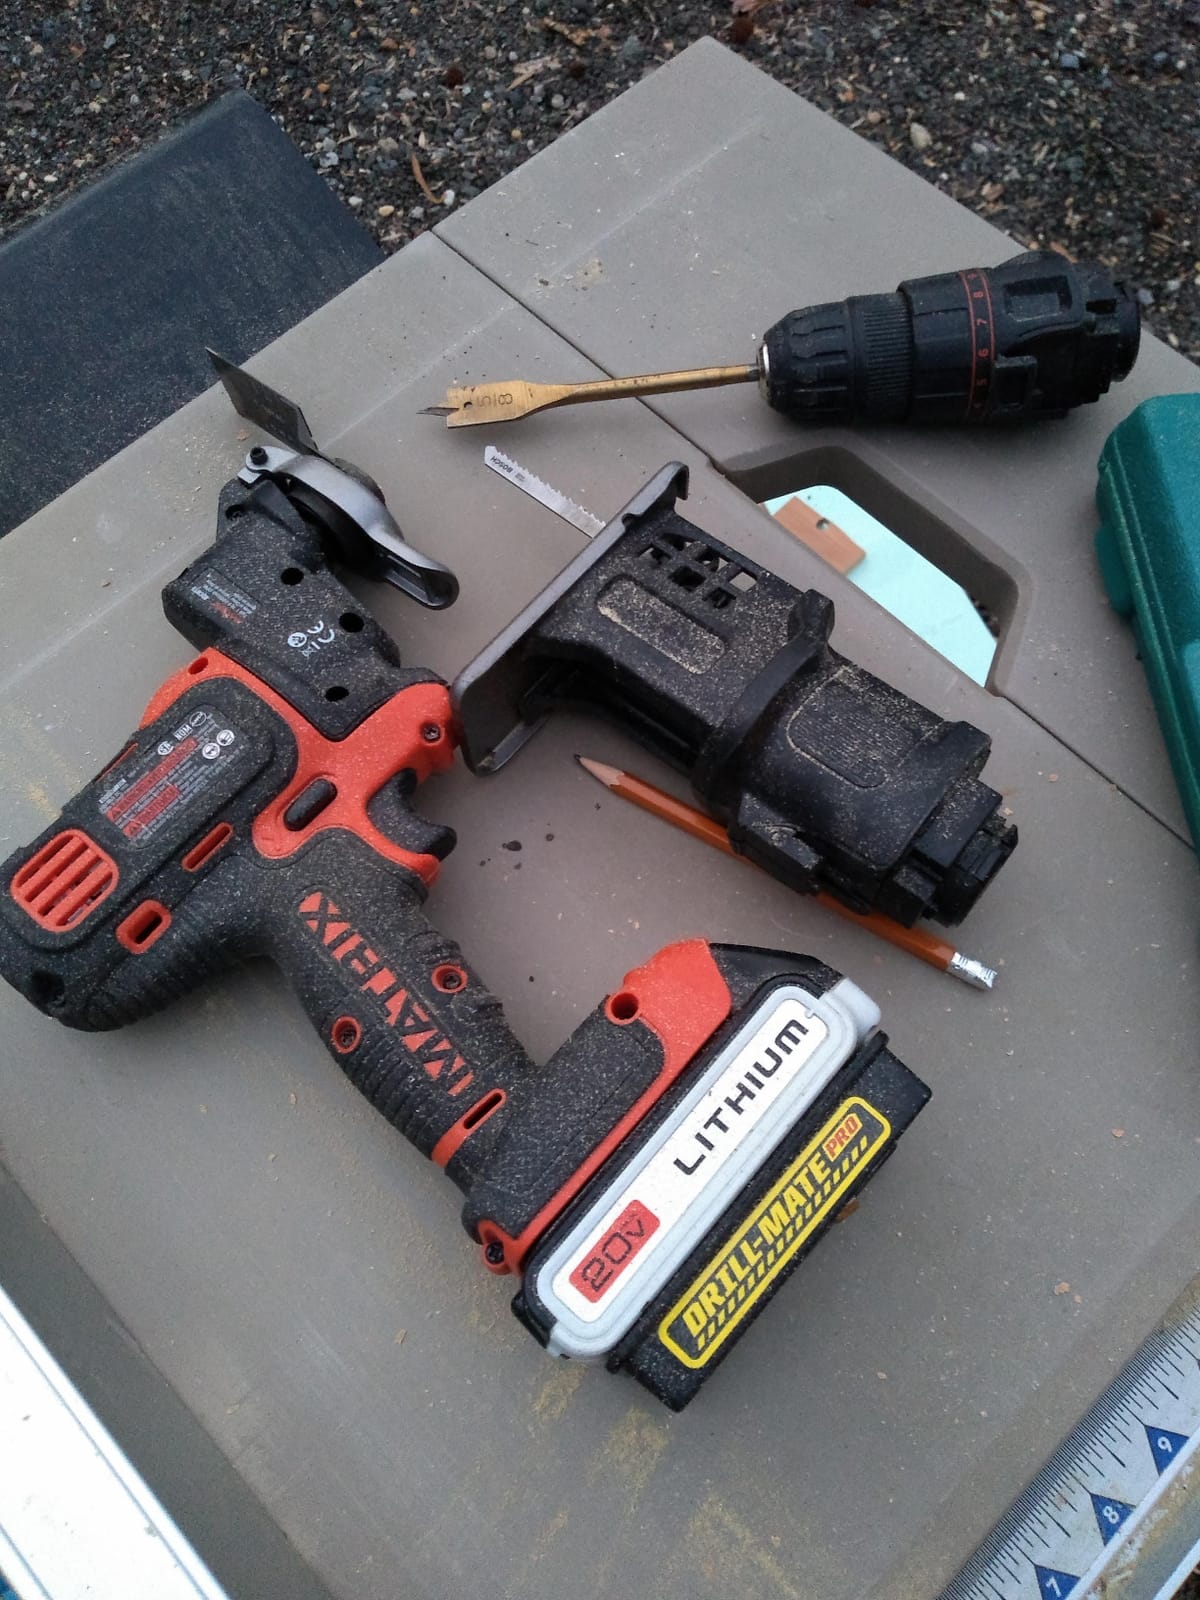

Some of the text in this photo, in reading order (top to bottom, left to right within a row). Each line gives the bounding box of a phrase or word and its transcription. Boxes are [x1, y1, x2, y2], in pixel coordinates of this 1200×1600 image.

[976, 318, 987, 326] 7
[979, 348, 988, 358] 6
[490, 455, 514, 474] BOSCH
[174, 725, 192, 740] NOM
[298, 891, 475, 1097] MATRIX
[673, 1019, 809, 1176] LITHIUM
[681, 1114, 861, 1338] DRILL-MATE PRO
[1157, 1436, 1173, 1453] 9
[1103, 1505, 1120, 1525] 8
[1045, 1576, 1063, 1598] 7
